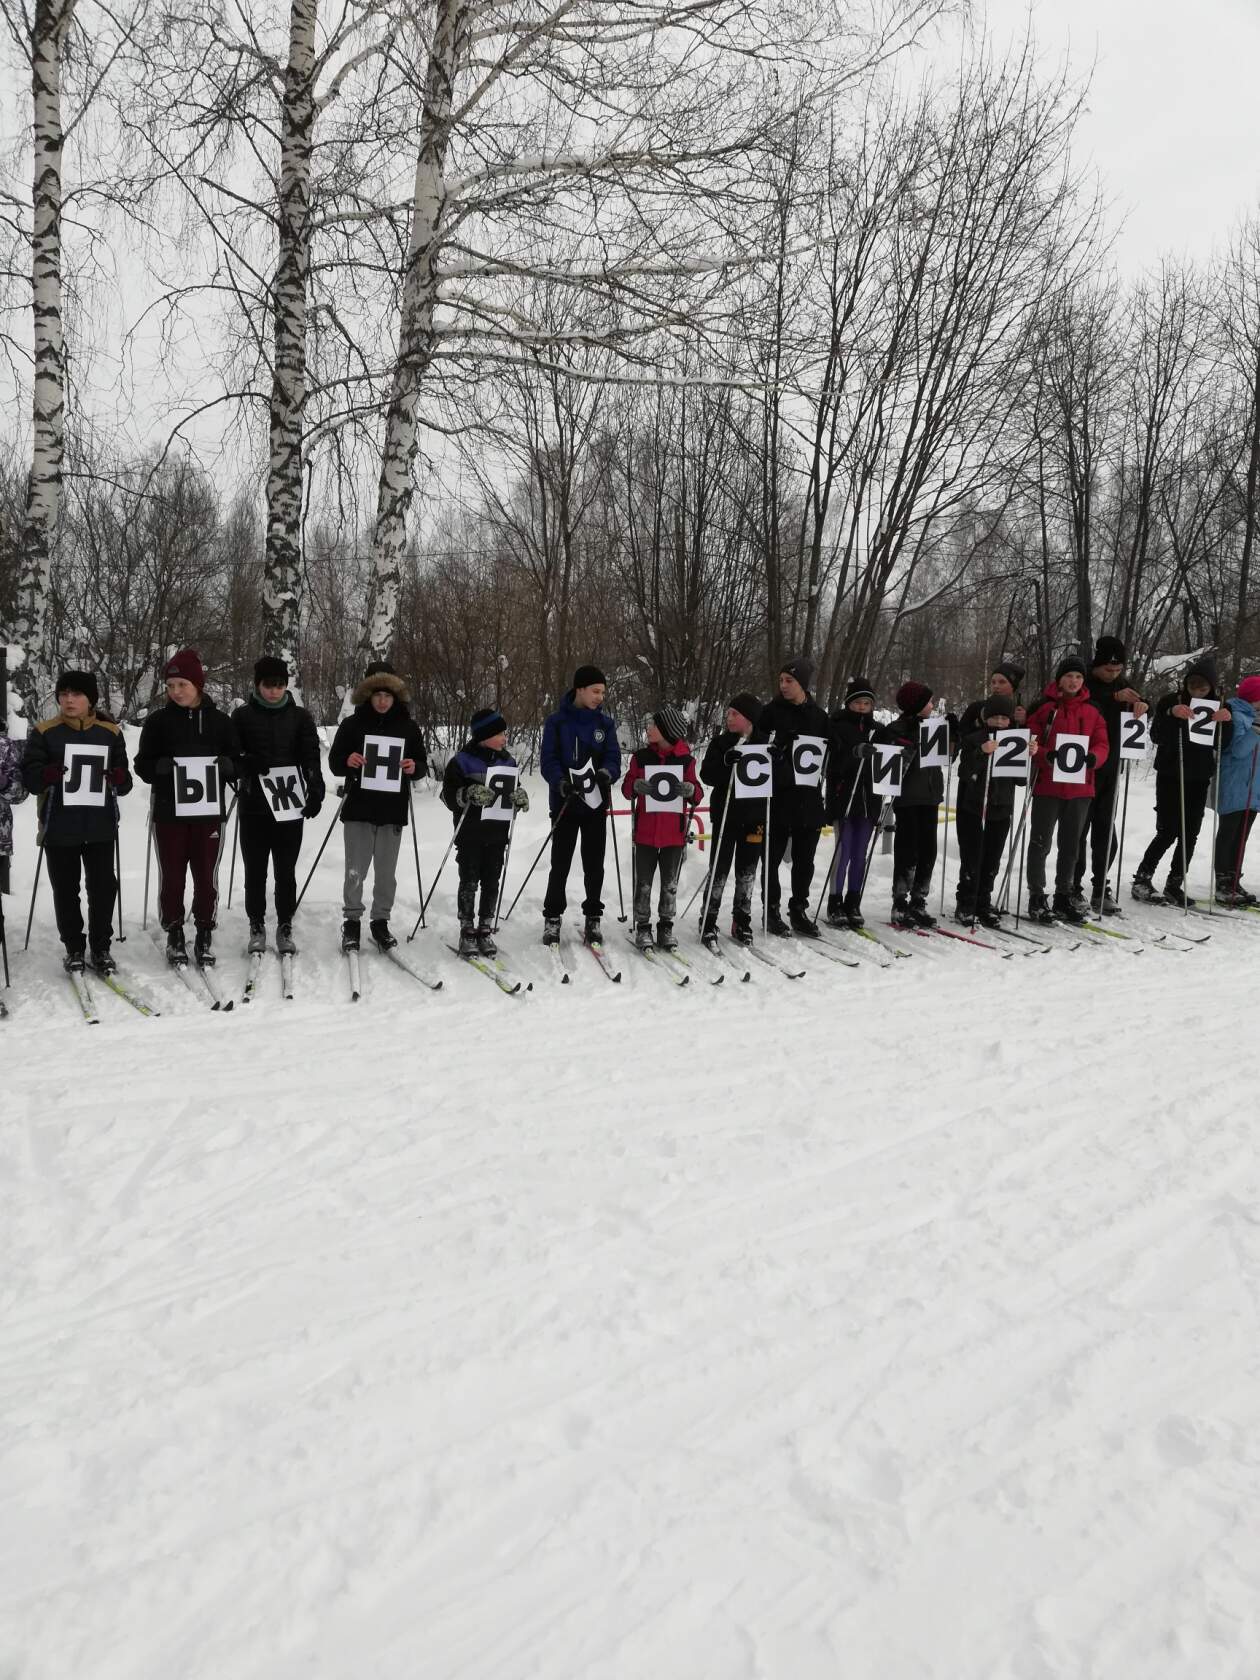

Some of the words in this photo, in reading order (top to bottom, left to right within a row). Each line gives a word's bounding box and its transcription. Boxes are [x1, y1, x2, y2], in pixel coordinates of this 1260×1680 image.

[1123, 719, 1145, 749] 2
[1191, 706, 1215, 735] 2
[921, 724, 947, 757] И
[995, 736, 1028, 767] 2
[65, 754, 105, 793] Л
[364, 743, 401, 780] Н
[737, 753, 771, 786] С
[794, 744, 822, 775] С
[874, 751, 903, 786] И
[177, 765, 217, 803] Ы
[265, 774, 302, 811] Ж
[484, 774, 516, 809] Я
[648, 772, 681, 802] О
